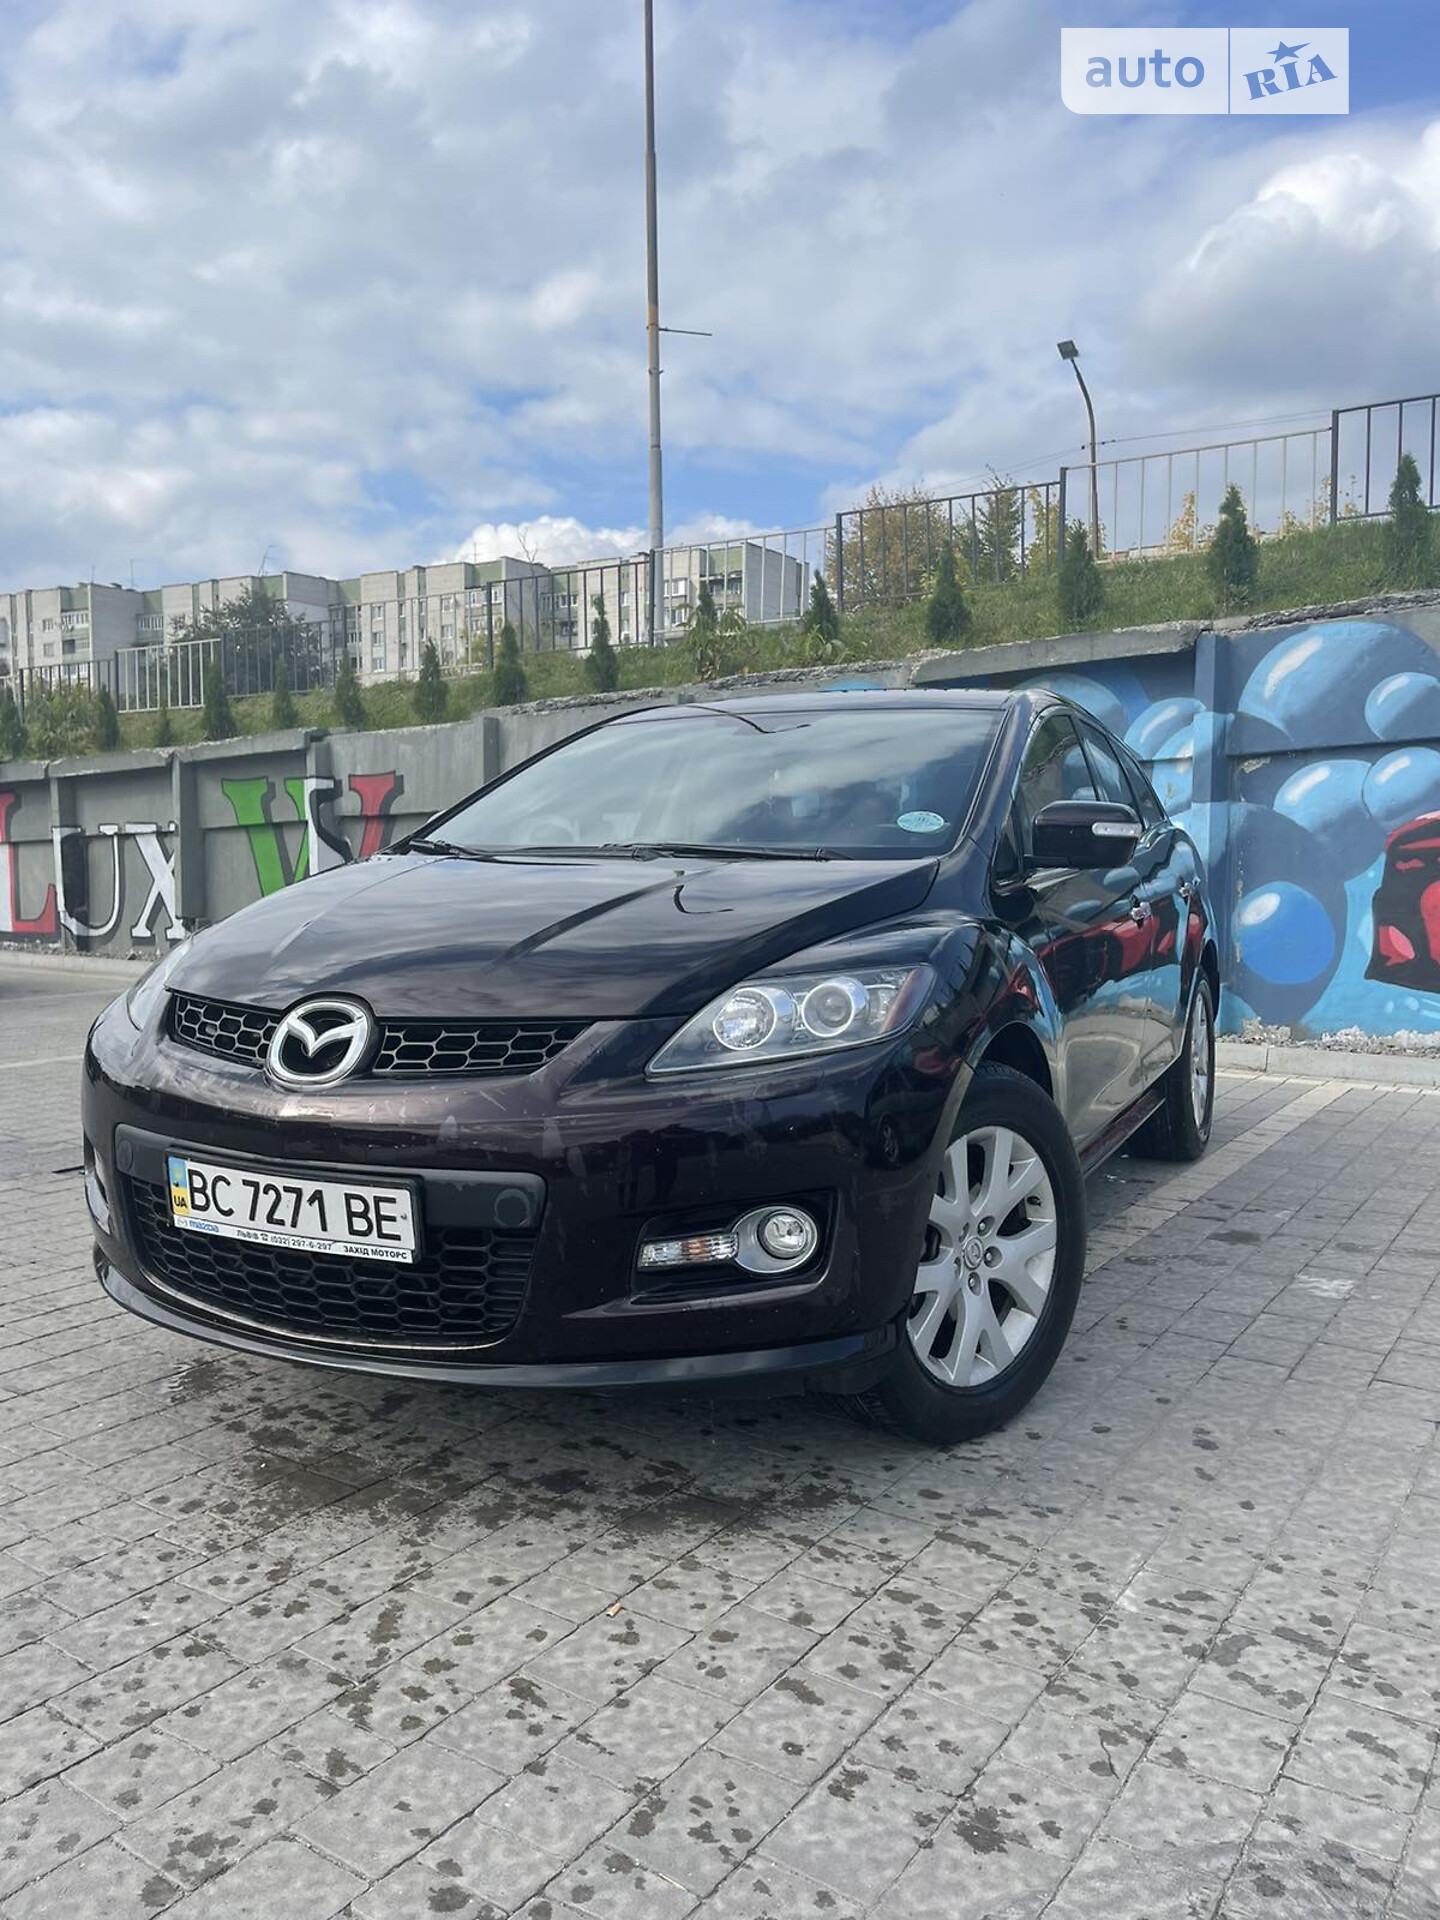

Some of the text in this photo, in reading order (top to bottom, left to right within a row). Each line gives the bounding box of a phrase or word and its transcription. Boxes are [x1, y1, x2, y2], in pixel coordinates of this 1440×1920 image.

[173, 1168, 401, 1242] UA BC 7271 BE
[343, 1245, 407, 1260] ЗАХІД МОТОРС
